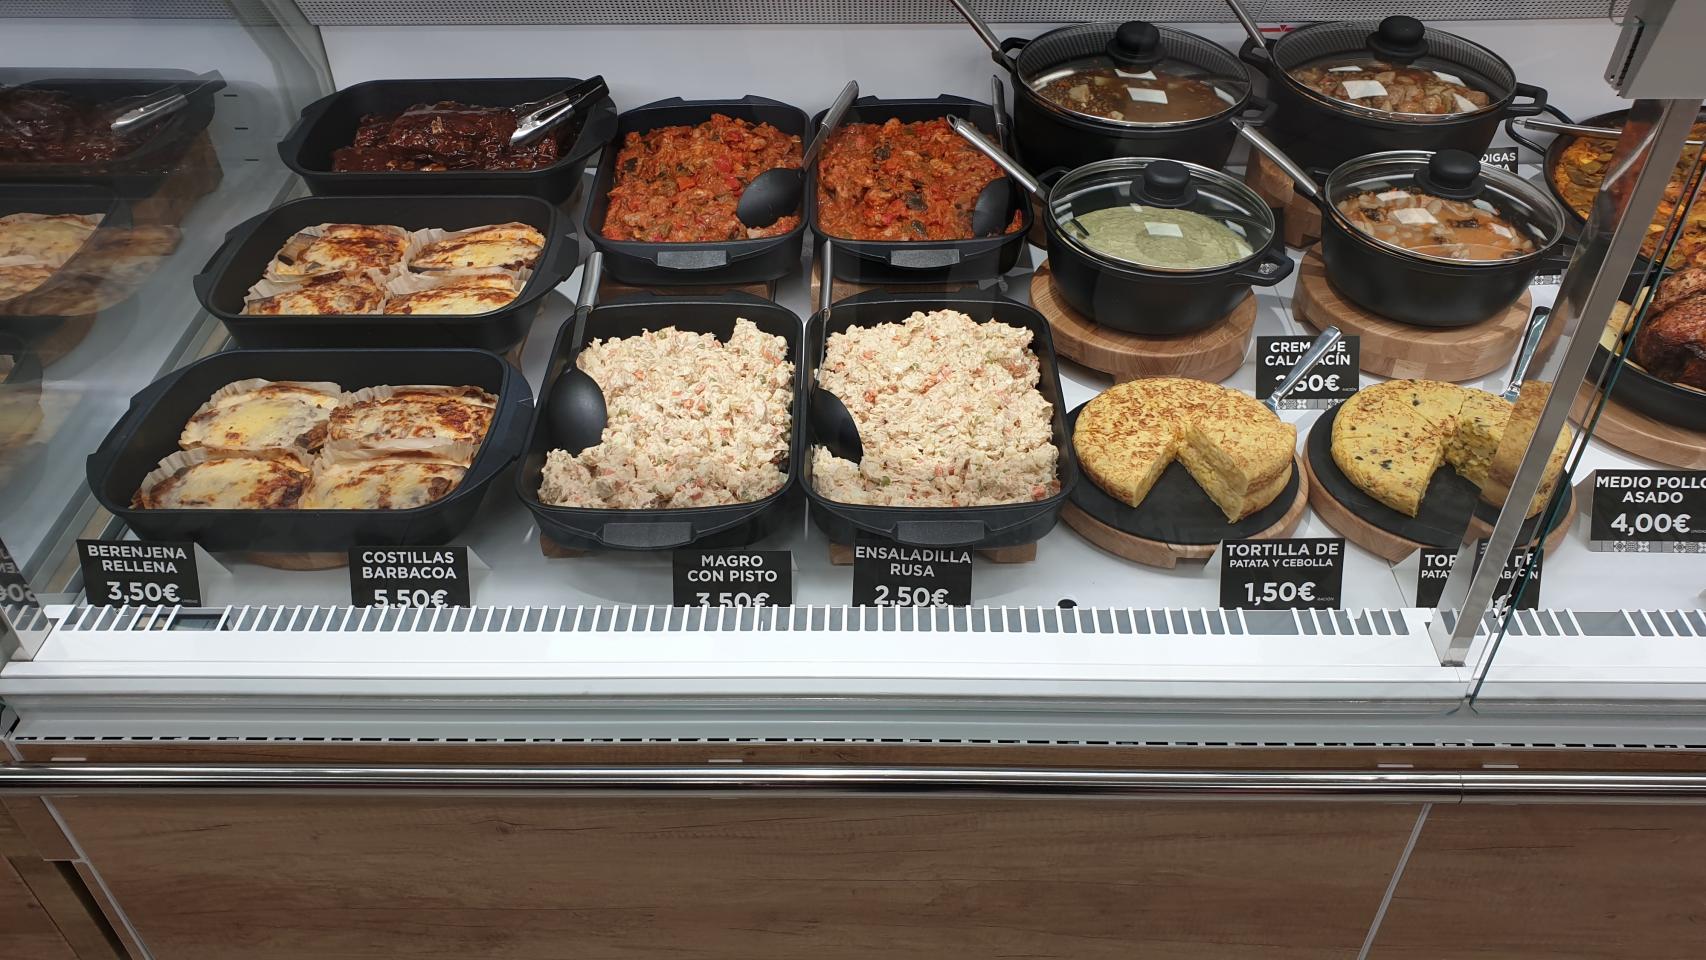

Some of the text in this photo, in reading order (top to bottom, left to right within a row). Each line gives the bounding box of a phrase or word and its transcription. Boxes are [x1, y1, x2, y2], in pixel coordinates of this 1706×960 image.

[1270, 341, 1311, 353] CREM
[1264, 352, 1350, 366] CALACÍN
[1596, 476, 1652, 489] MEDIO
[1622, 491, 1684, 504] ASADO
[1610, 512, 1691, 536] 4,00€
[87, 544, 188, 560] BERENJENA
[855, 545, 972, 564] ENSALADILLA
[1226, 543, 1339, 557] TORTILLA DE
[362, 551, 455, 564] COSTILLAS
[701, 554, 763, 567] MAGRO
[1229, 558, 1333, 568] PATATA Y CEBOLLA
[101, 559, 178, 574] RELLENA
[362, 566, 457, 579] BARBACOA
[890, 563, 935, 578] RUSA
[1421, 569, 1451, 578] PATA
[687, 569, 778, 582] CON PISTO
[106, 581, 181, 604] 3,50€
[874, 584, 949, 608] 2,50€
[1244, 581, 1316, 606] 1,50€
[696, 592, 770, 608] 350€
